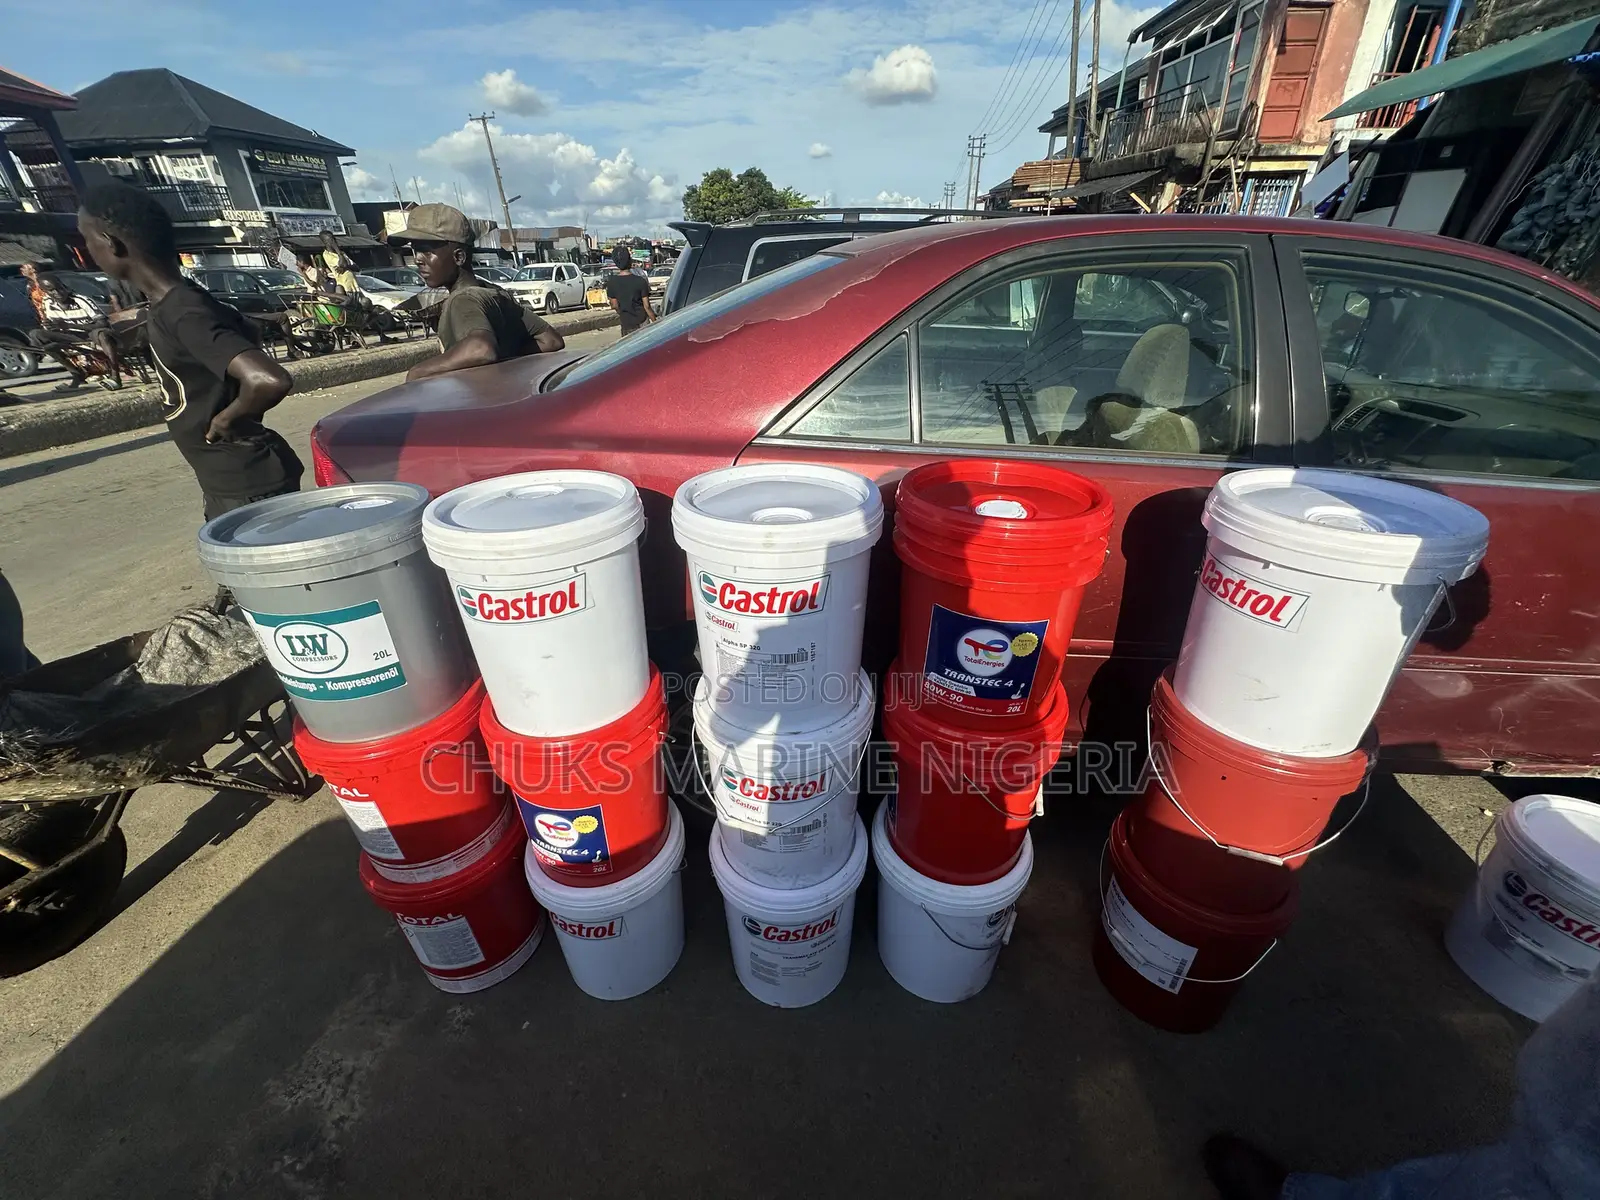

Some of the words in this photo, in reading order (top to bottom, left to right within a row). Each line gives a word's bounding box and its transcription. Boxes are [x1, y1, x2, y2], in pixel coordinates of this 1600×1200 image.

[719, 581, 820, 614] Castrol
[1202, 558, 1292, 622] Castrol
[478, 581, 580, 621] Castrol
[711, 615, 735, 630] Castrol
[373, 649, 392, 661] 20L
[964, 655, 1005, 668] TotalEnergies
[944, 668, 1002, 687] TRANSTEC
[1004, 679, 1014, 688] 4
[924, 681, 964, 703] 80W-90
[1006, 705, 1021, 713] 20L
[330, 783, 369, 797] TAL
[739, 773, 826, 802] Castrol
[735, 799, 760, 812] Castrol
[535, 838, 578, 856] TRANSTEC
[396, 912, 463, 925] TOTAL
[550, 913, 617, 938] Castrol
[763, 911, 838, 942] Castrol
[1522, 893, 1600, 948] Castr
